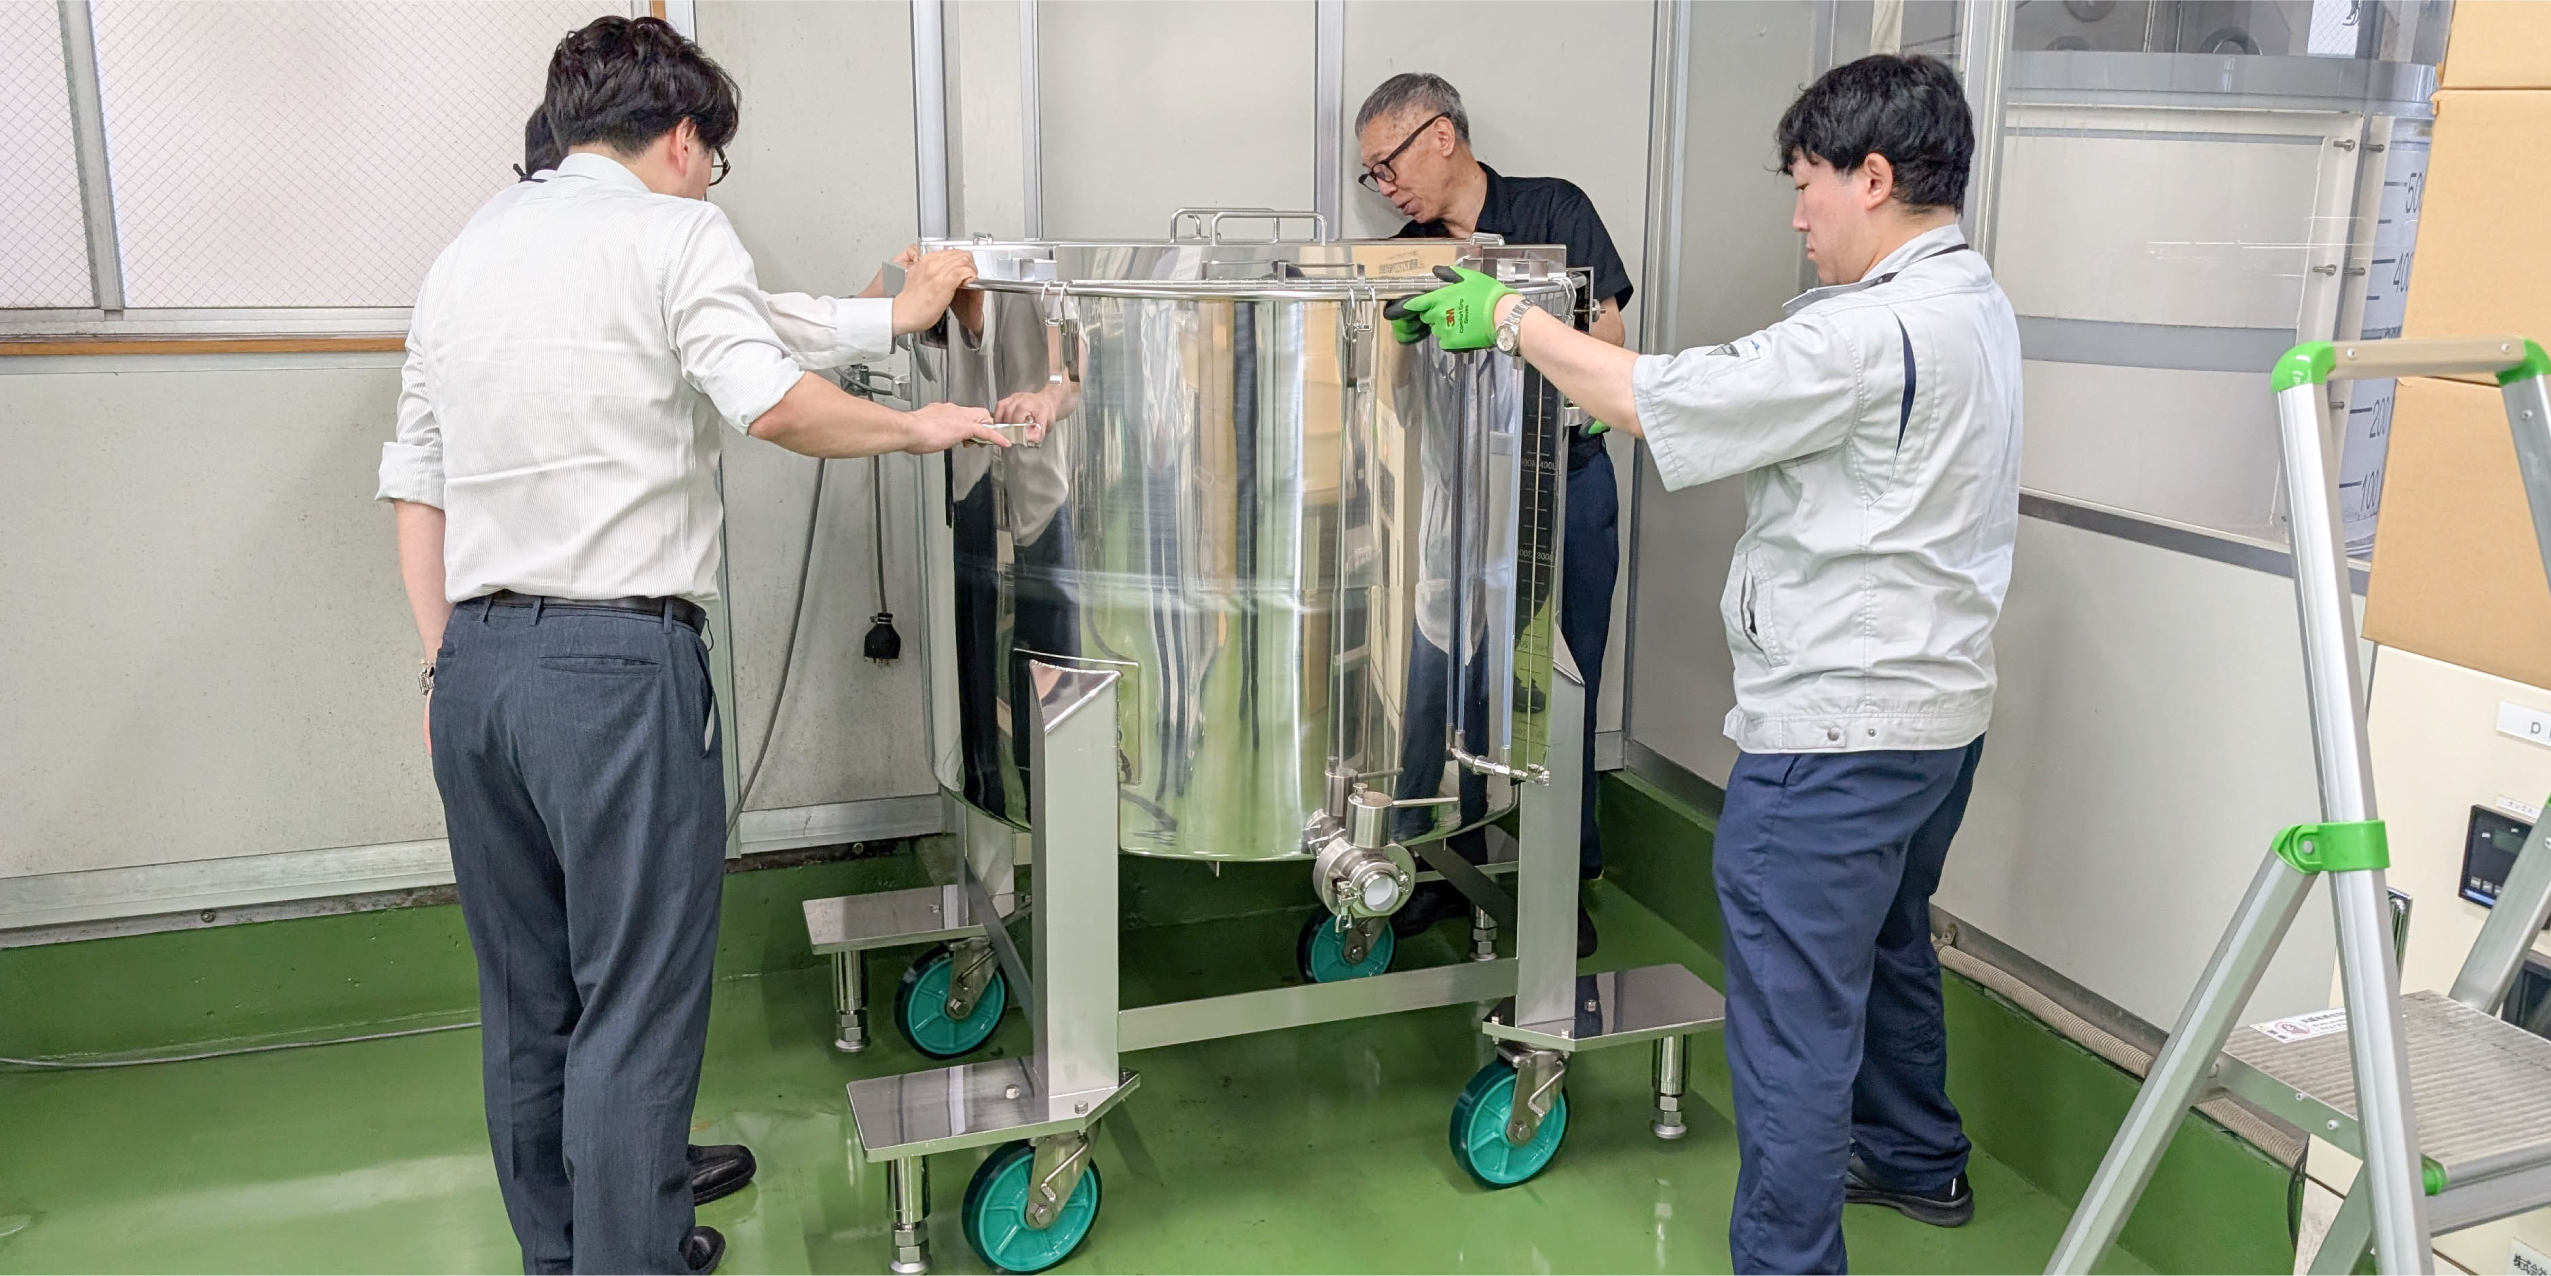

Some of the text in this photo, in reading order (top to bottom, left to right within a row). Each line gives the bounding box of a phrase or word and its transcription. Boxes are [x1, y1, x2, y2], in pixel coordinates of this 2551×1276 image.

[2405, 172, 2423, 214] 50
[1446, 308, 1455, 327] 3M
[2360, 469, 2379, 511] 100
[1536, 551, 1552, 561] 300
